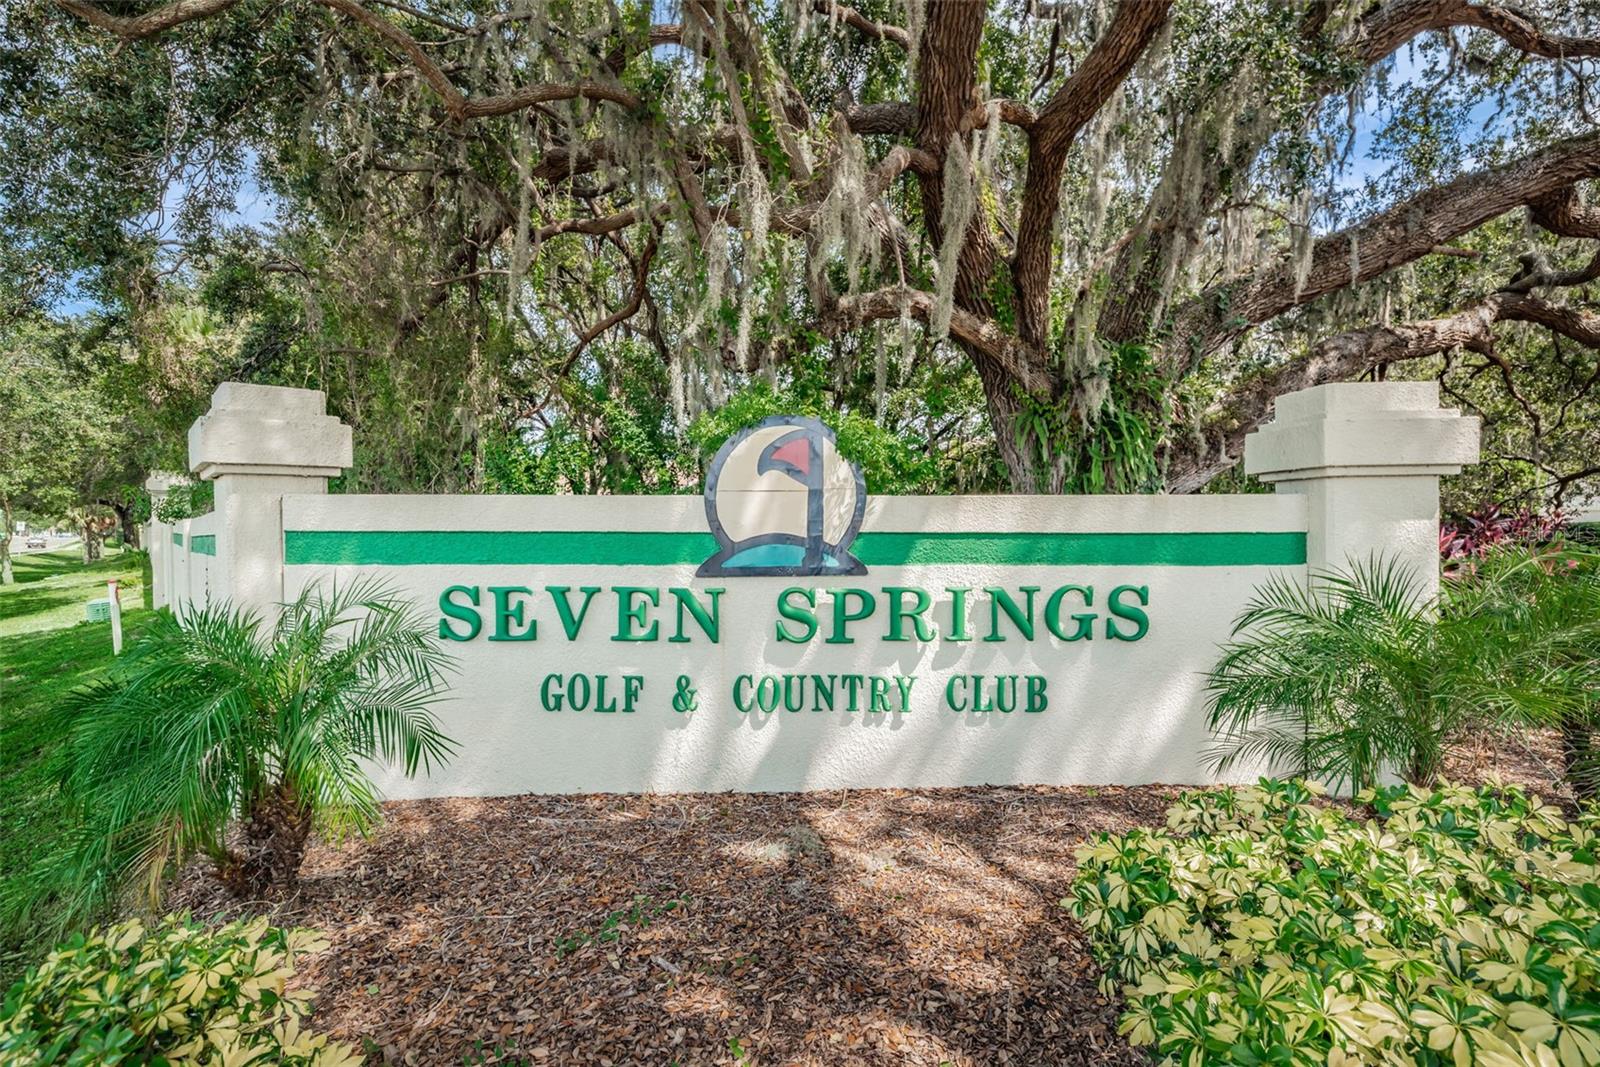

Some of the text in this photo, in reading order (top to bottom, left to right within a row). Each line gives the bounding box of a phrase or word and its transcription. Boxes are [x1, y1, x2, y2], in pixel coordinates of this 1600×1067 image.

[437, 584, 1150, 645] SEVEN SPRINGS
[539, 671, 1050, 714] GOLF & COUNTRY CLUB
